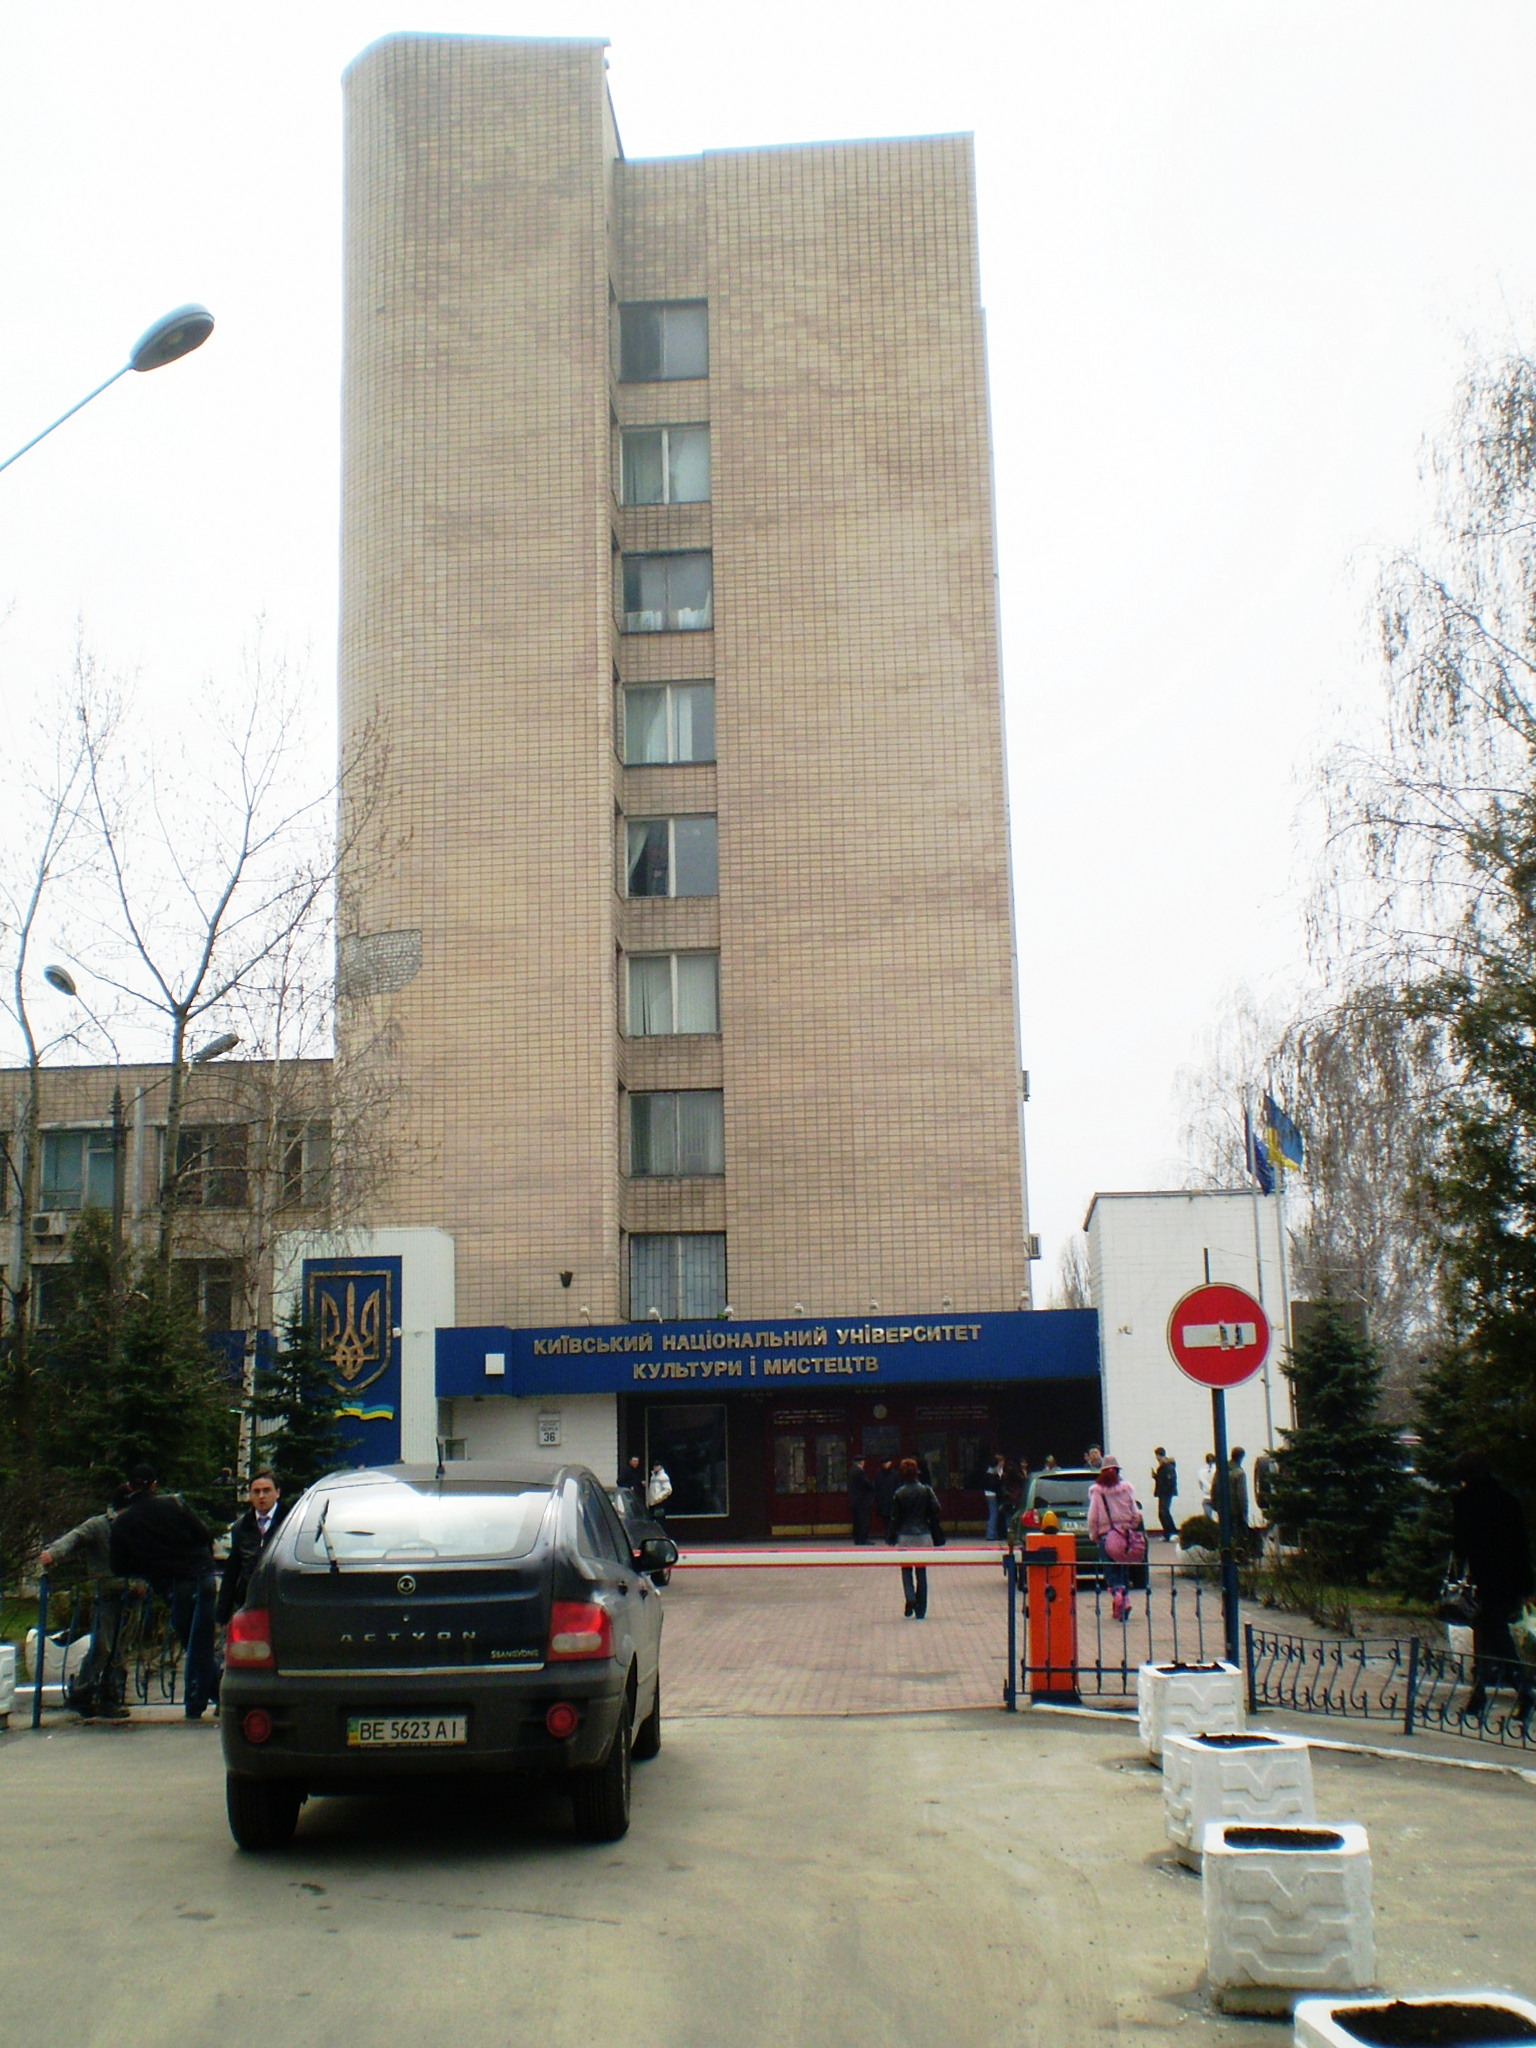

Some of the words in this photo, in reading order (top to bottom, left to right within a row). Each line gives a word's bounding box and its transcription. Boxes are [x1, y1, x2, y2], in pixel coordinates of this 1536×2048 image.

[533, 1333, 652, 1355] КИЇВСЬКИЙ
[633, 1360, 742, 1379] КУЛЬТУРИ
[763, 1356, 879, 1376] МИСТЕЦТВ
[543, 1432, 556, 1442] 36
[341, 1631, 476, 1641] ACTYON
[490, 1649, 539, 1659] SSANGYONG
[360, 1722, 385, 1741] BE
[391, 1721, 430, 1740] 5623
